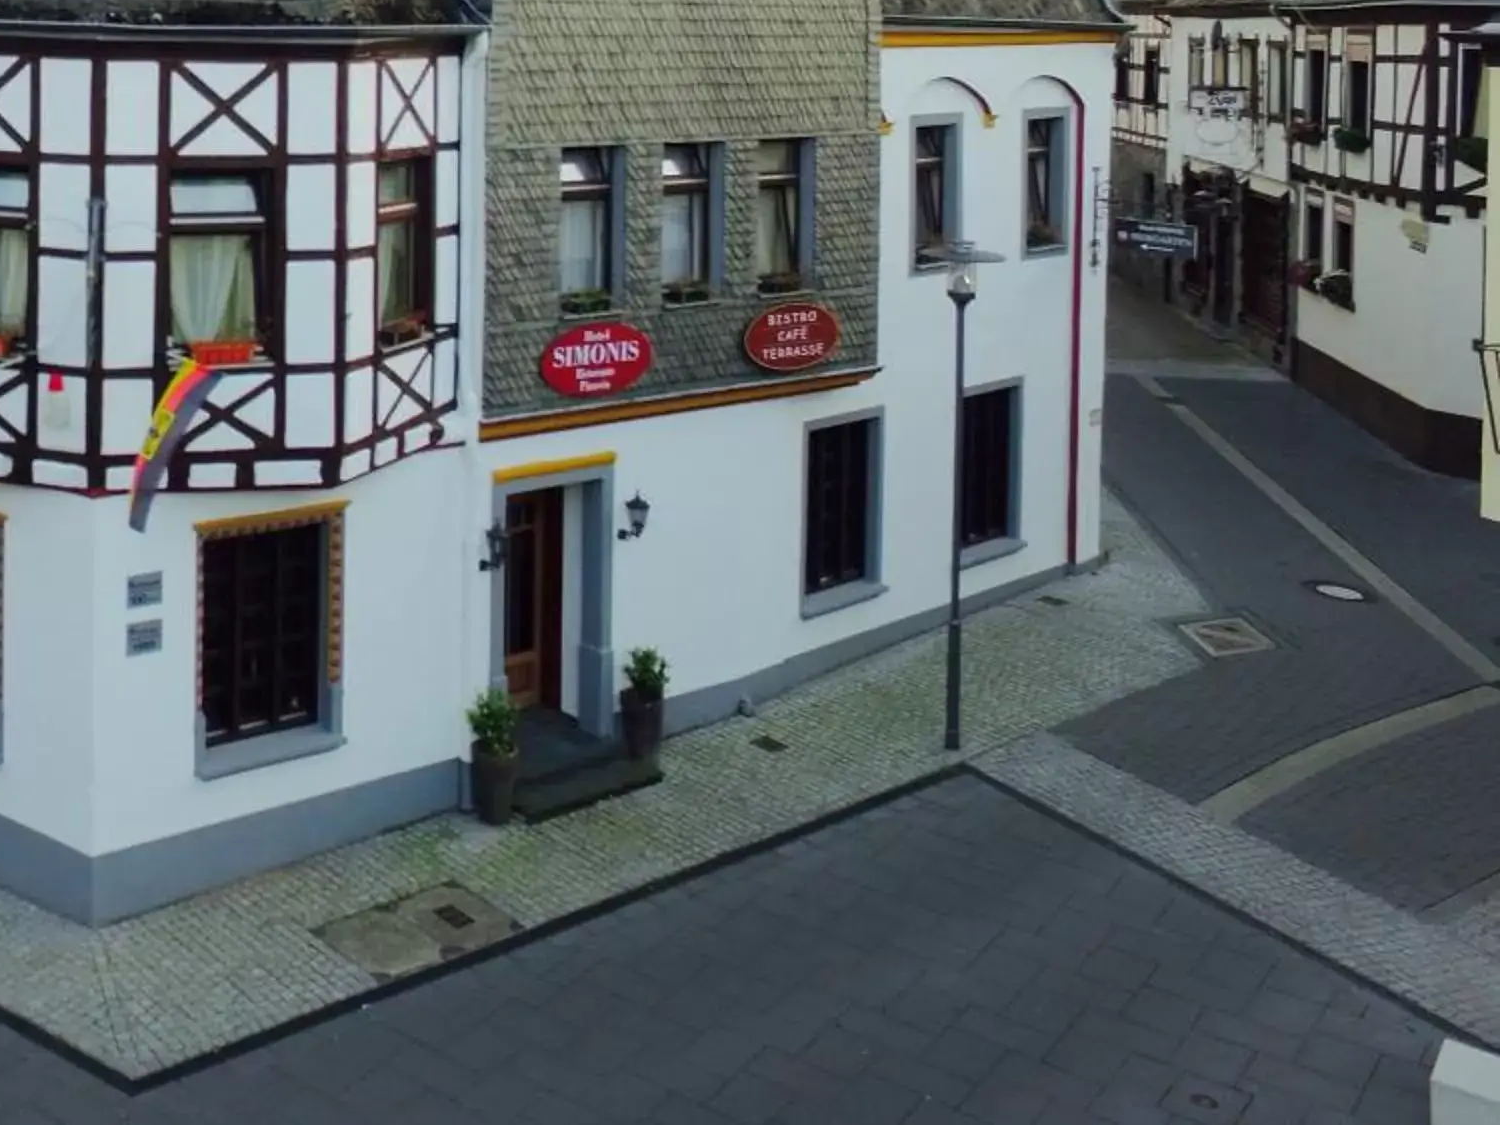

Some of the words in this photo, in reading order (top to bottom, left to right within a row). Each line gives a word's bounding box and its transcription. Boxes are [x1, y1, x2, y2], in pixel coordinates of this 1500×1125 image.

[767, 310, 817, 326] BISTRO
[777, 324, 808, 342] CAFÉ
[552, 340, 639, 368] SIMONIS
[762, 342, 824, 360] TERRASSE
